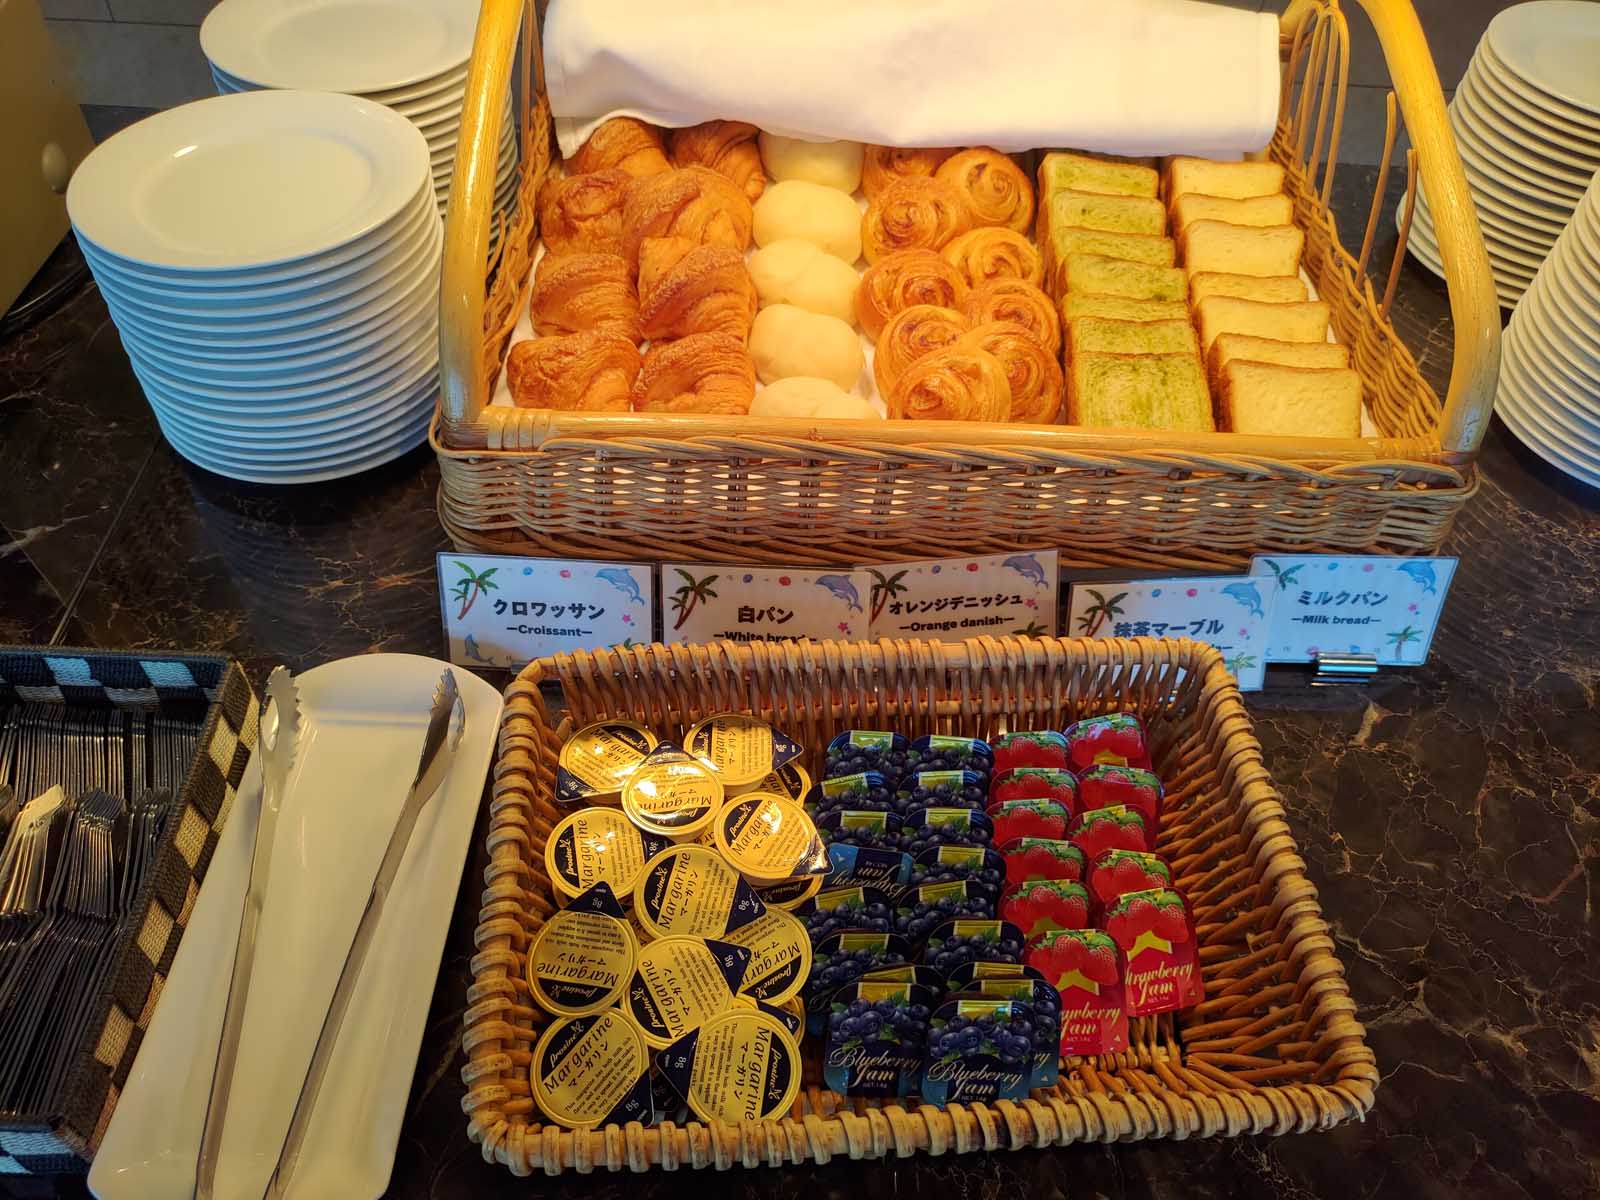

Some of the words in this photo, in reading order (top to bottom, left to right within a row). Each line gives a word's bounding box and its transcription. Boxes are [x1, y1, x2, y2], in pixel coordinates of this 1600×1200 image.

[493, 599, 605, 620] クロワッサン
[889, 593, 1023, 615] オレンジデニッシュ
[1298, 590, 1388, 607] ミルクパン
[738, 606, 793, 624] 白パン
[1113, 619, 1224, 638] 抹茶マーブル
[658, 852, 693, 929] Margarine
[677, 870, 699, 917] マーガリン
[592, 897, 602, 908] 8g
[737, 898, 750, 911] 8g
[556, 952, 606, 966] マーガリン
[722, 954, 736, 967] 8g
[536, 963, 619, 986] Margarine
[641, 958, 688, 1035] Margarine
[662, 966, 692, 1016] マーガリン
[1137, 982, 1173, 1007] Jam
[544, 1016, 614, 1095] Margarine
[565, 1038, 612, 1089] マーガリン
[674, 1056, 686, 1069] 8g
[828, 1045, 922, 1078] Blueberry
[733, 1041, 749, 1100] マーガリン
[745, 1025, 769, 1121] Margarine
[844, 1064, 896, 1089] Jam
[927, 1058, 1024, 1090] Blueberry
[945, 1078, 996, 1100] Jam
[625, 1099, 639, 1112] 8g
